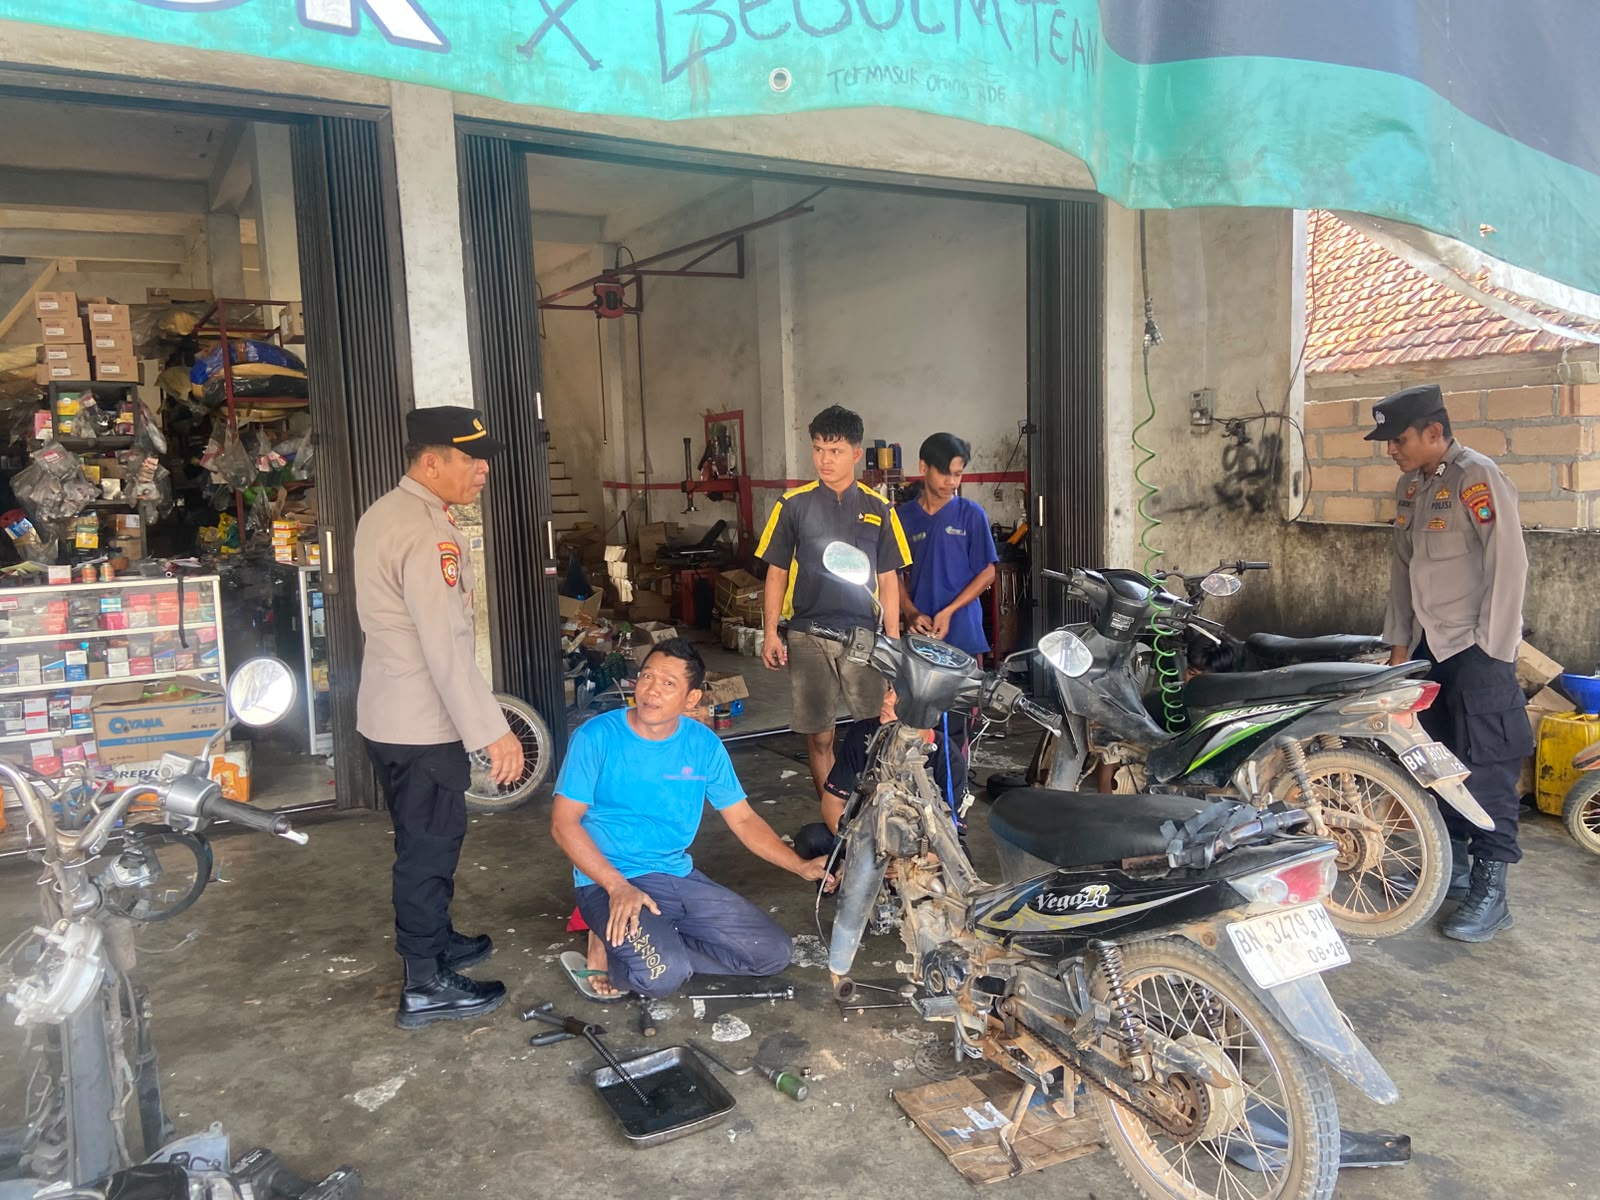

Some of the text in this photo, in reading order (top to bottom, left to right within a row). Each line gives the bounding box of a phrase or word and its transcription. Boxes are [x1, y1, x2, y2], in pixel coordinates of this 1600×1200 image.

[1403, 750, 1427, 771] BN
[625, 924, 667, 980] UNLOP
[1233, 906, 1335, 955] BN 3479 PM
